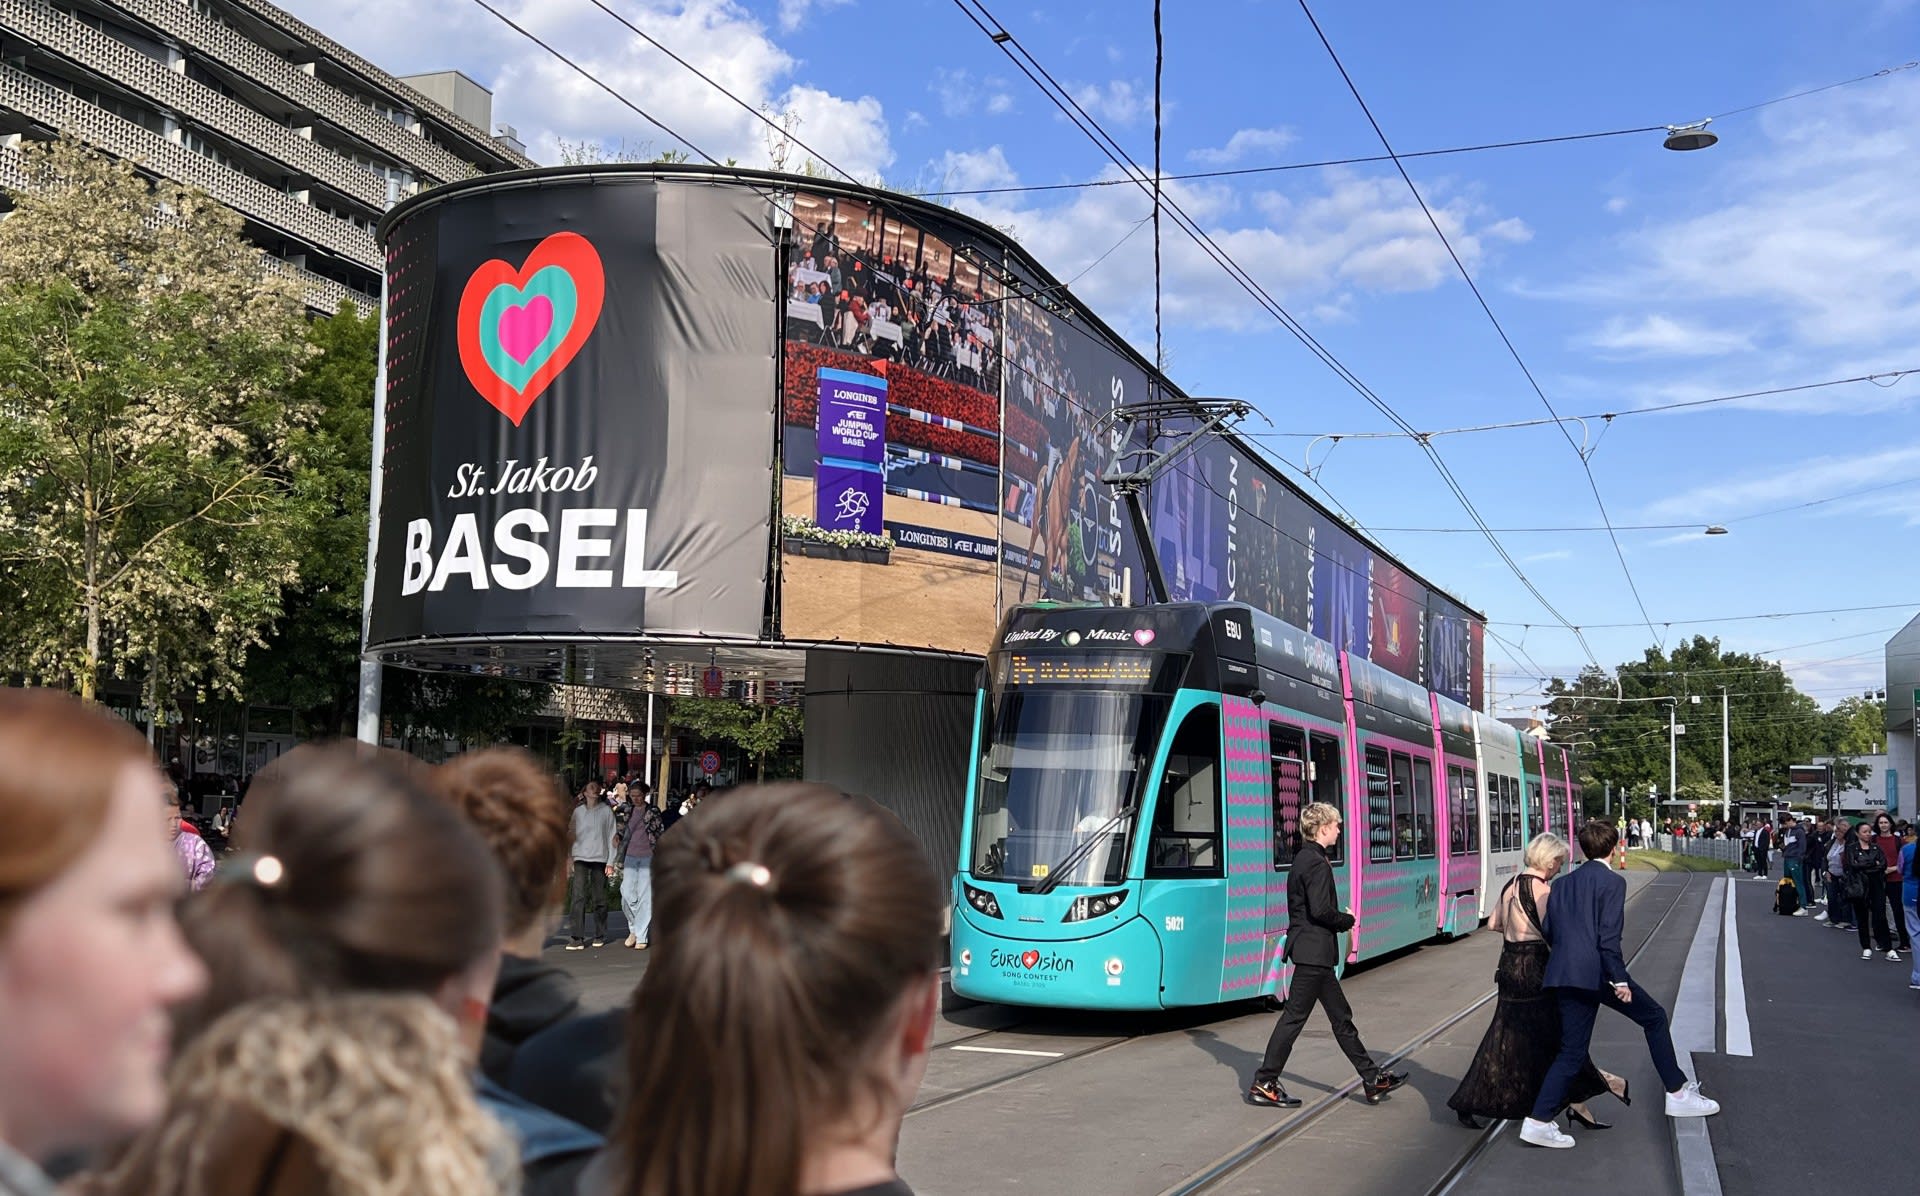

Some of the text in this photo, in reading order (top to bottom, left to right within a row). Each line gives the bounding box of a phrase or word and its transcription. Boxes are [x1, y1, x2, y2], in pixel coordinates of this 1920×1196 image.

[833, 389, 878, 405] LONGINES
[837, 418, 874, 432] JUMPING
[831, 426, 880, 441] WORLD CUP
[842, 436, 866, 448] BASEL
[447, 455, 599, 499] St. Jakob
[900, 529, 949, 549] LONGINES
[401, 507, 679, 597] BASEL
[1004, 629, 1132, 644] United By Music
[1225, 619, 1242, 640] EBU
[1165, 916, 1184, 931] 5021
[1002, 971, 1058, 982] SONG CONTEST
